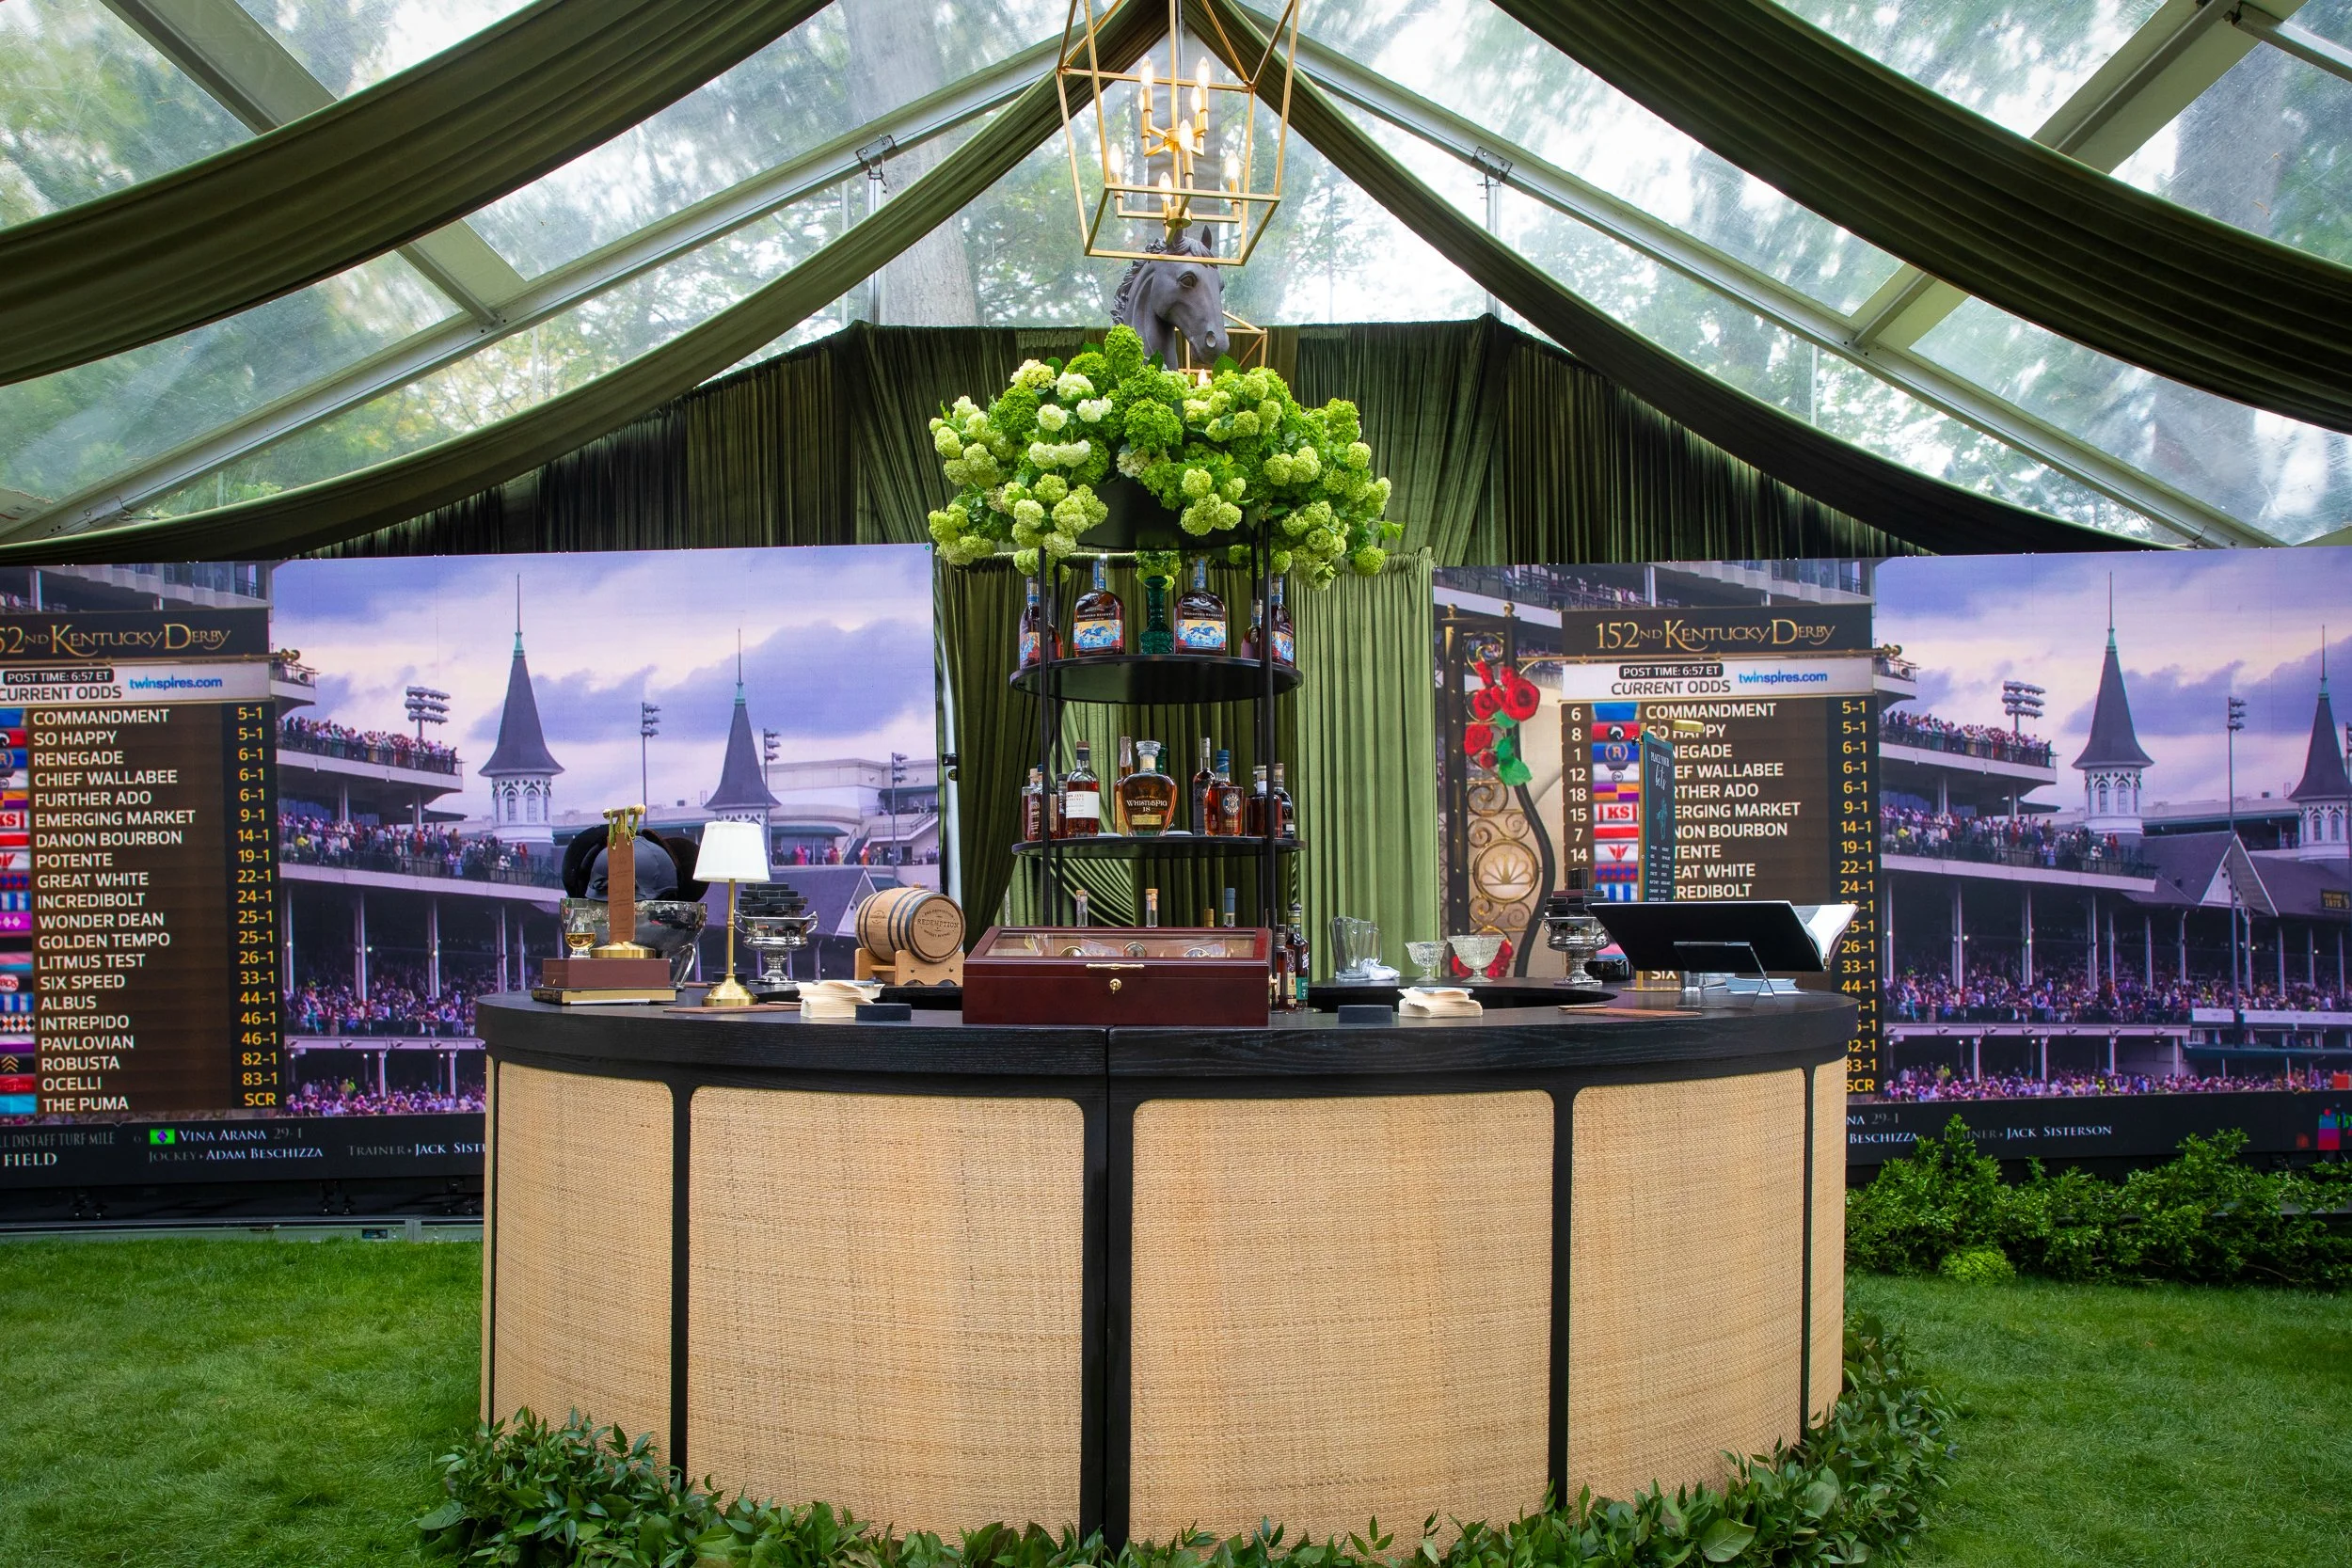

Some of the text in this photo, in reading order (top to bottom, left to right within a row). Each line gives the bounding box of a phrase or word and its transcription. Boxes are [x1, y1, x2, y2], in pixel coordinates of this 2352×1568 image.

[51, 624, 163, 657] KENTUCKY
[164, 624, 230, 650] DERBY
[1597, 618, 1836, 652] 152ND KENTUCKY DERBY
[7, 671, 109, 683] POST TIME: 6:57 ET
[1623, 665, 1719, 677] POST TIME: 6:57 ET
[1739, 670, 1828, 684] twinspires.com
[130, 674, 222, 689] twinspires.com
[1612, 680, 1731, 695] CURRENT ODDS
[79, 686, 121, 699] ODDS
[32, 706, 262, 726] COMMANDMENT 5-1
[1571, 700, 1866, 722] 6 COMMANDMENT 5-1
[33, 727, 262, 747] SO HAPPY 5-1
[1571, 727, 1582, 742] 8
[1673, 724, 1725, 738] HAPY
[1842, 721, 1867, 735] 5-1
[33, 751, 124, 767] RENEGADE
[238, 747, 263, 761] 6-1
[1573, 747, 1581, 762] 1
[1673, 744, 1732, 759] NEGADE
[1842, 740, 1867, 754] 6-1
[34, 768, 263, 787] CHIEF WALLABEE 6-1
[1569, 768, 1586, 782] 12
[1696, 762, 1784, 779] WALLABEE
[1843, 760, 1867, 774] 6-1
[35, 787, 264, 807] FURTHER ADO 6-1
[1569, 780, 1867, 802] 18 THER ADO 6-1
[35, 811, 122, 828] EMERGING
[126, 809, 196, 825] MARKET
[240, 808, 265, 822] 9-1
[1569, 800, 1867, 822] 15 KS ERGING MARKET 9-1
[36, 829, 269, 848] DANON BOURBON 14-1
[1574, 820, 1871, 842] 7 NON BOURBON 14-1
[36, 848, 270, 868] POTENTE 19-1
[1570, 840, 1872, 863] 14 TENTE 19-1
[37, 869, 271, 889] GREAT WHITE 22-1
[1674, 860, 1873, 879] EAT WHITE 22-1
[1674, 879, 1873, 899] REDIBOLT 24-1
[37, 889, 272, 910] INCREDIBOLT 24-1
[38, 910, 273, 929] WONDER DEAN 25-1
[917, 918, 960, 928] REDEMPTION
[39, 929, 273, 950] GOLDEN TEMPO 25-1
[1841, 939, 1874, 954] 26-1
[39, 950, 274, 971] LITMUS TEST 26-1
[1842, 959, 1875, 974] 33-1
[40, 970, 275, 990] SIX SPEED 33-1
[1841, 979, 1876, 993] 44-1
[40, 990, 276, 1011] ALBUS 44-1
[40, 1011, 276, 1031] INTREPIDO 46-1
[40, 1031, 277, 1052] PAVLOVIAN 46-1
[41, 1052, 277, 1071] ROBUSTA 82-1
[41, 1076, 102, 1092] OCELLI
[242, 1071, 278, 1086] 83-1
[1846, 1078, 1875, 1092] SCR
[42, 1092, 276, 1113] THE PUMA SCR
[1870, 1113, 1899, 1126] 29-1
[12, 1134, 56, 1147] DISTAFF
[57, 1133, 86, 1146] TURF
[88, 1132, 116, 1145] MILE
[180, 1130, 215, 1142] VINA
[219, 1129, 266, 1141] ARANA
[2007, 1128, 2037, 1140] JACK
[2043, 1126, 2111, 1137] SISTERSON
[4, 1152, 57, 1166] FIELD
[149, 1150, 196, 1164] JOCKEY
[206, 1148, 246, 1160] ADAM
[250, 1147, 323, 1159] BESCHIZZA
[347, 1145, 405, 1156] TRAINER
[415, 1144, 446, 1155] JACK
